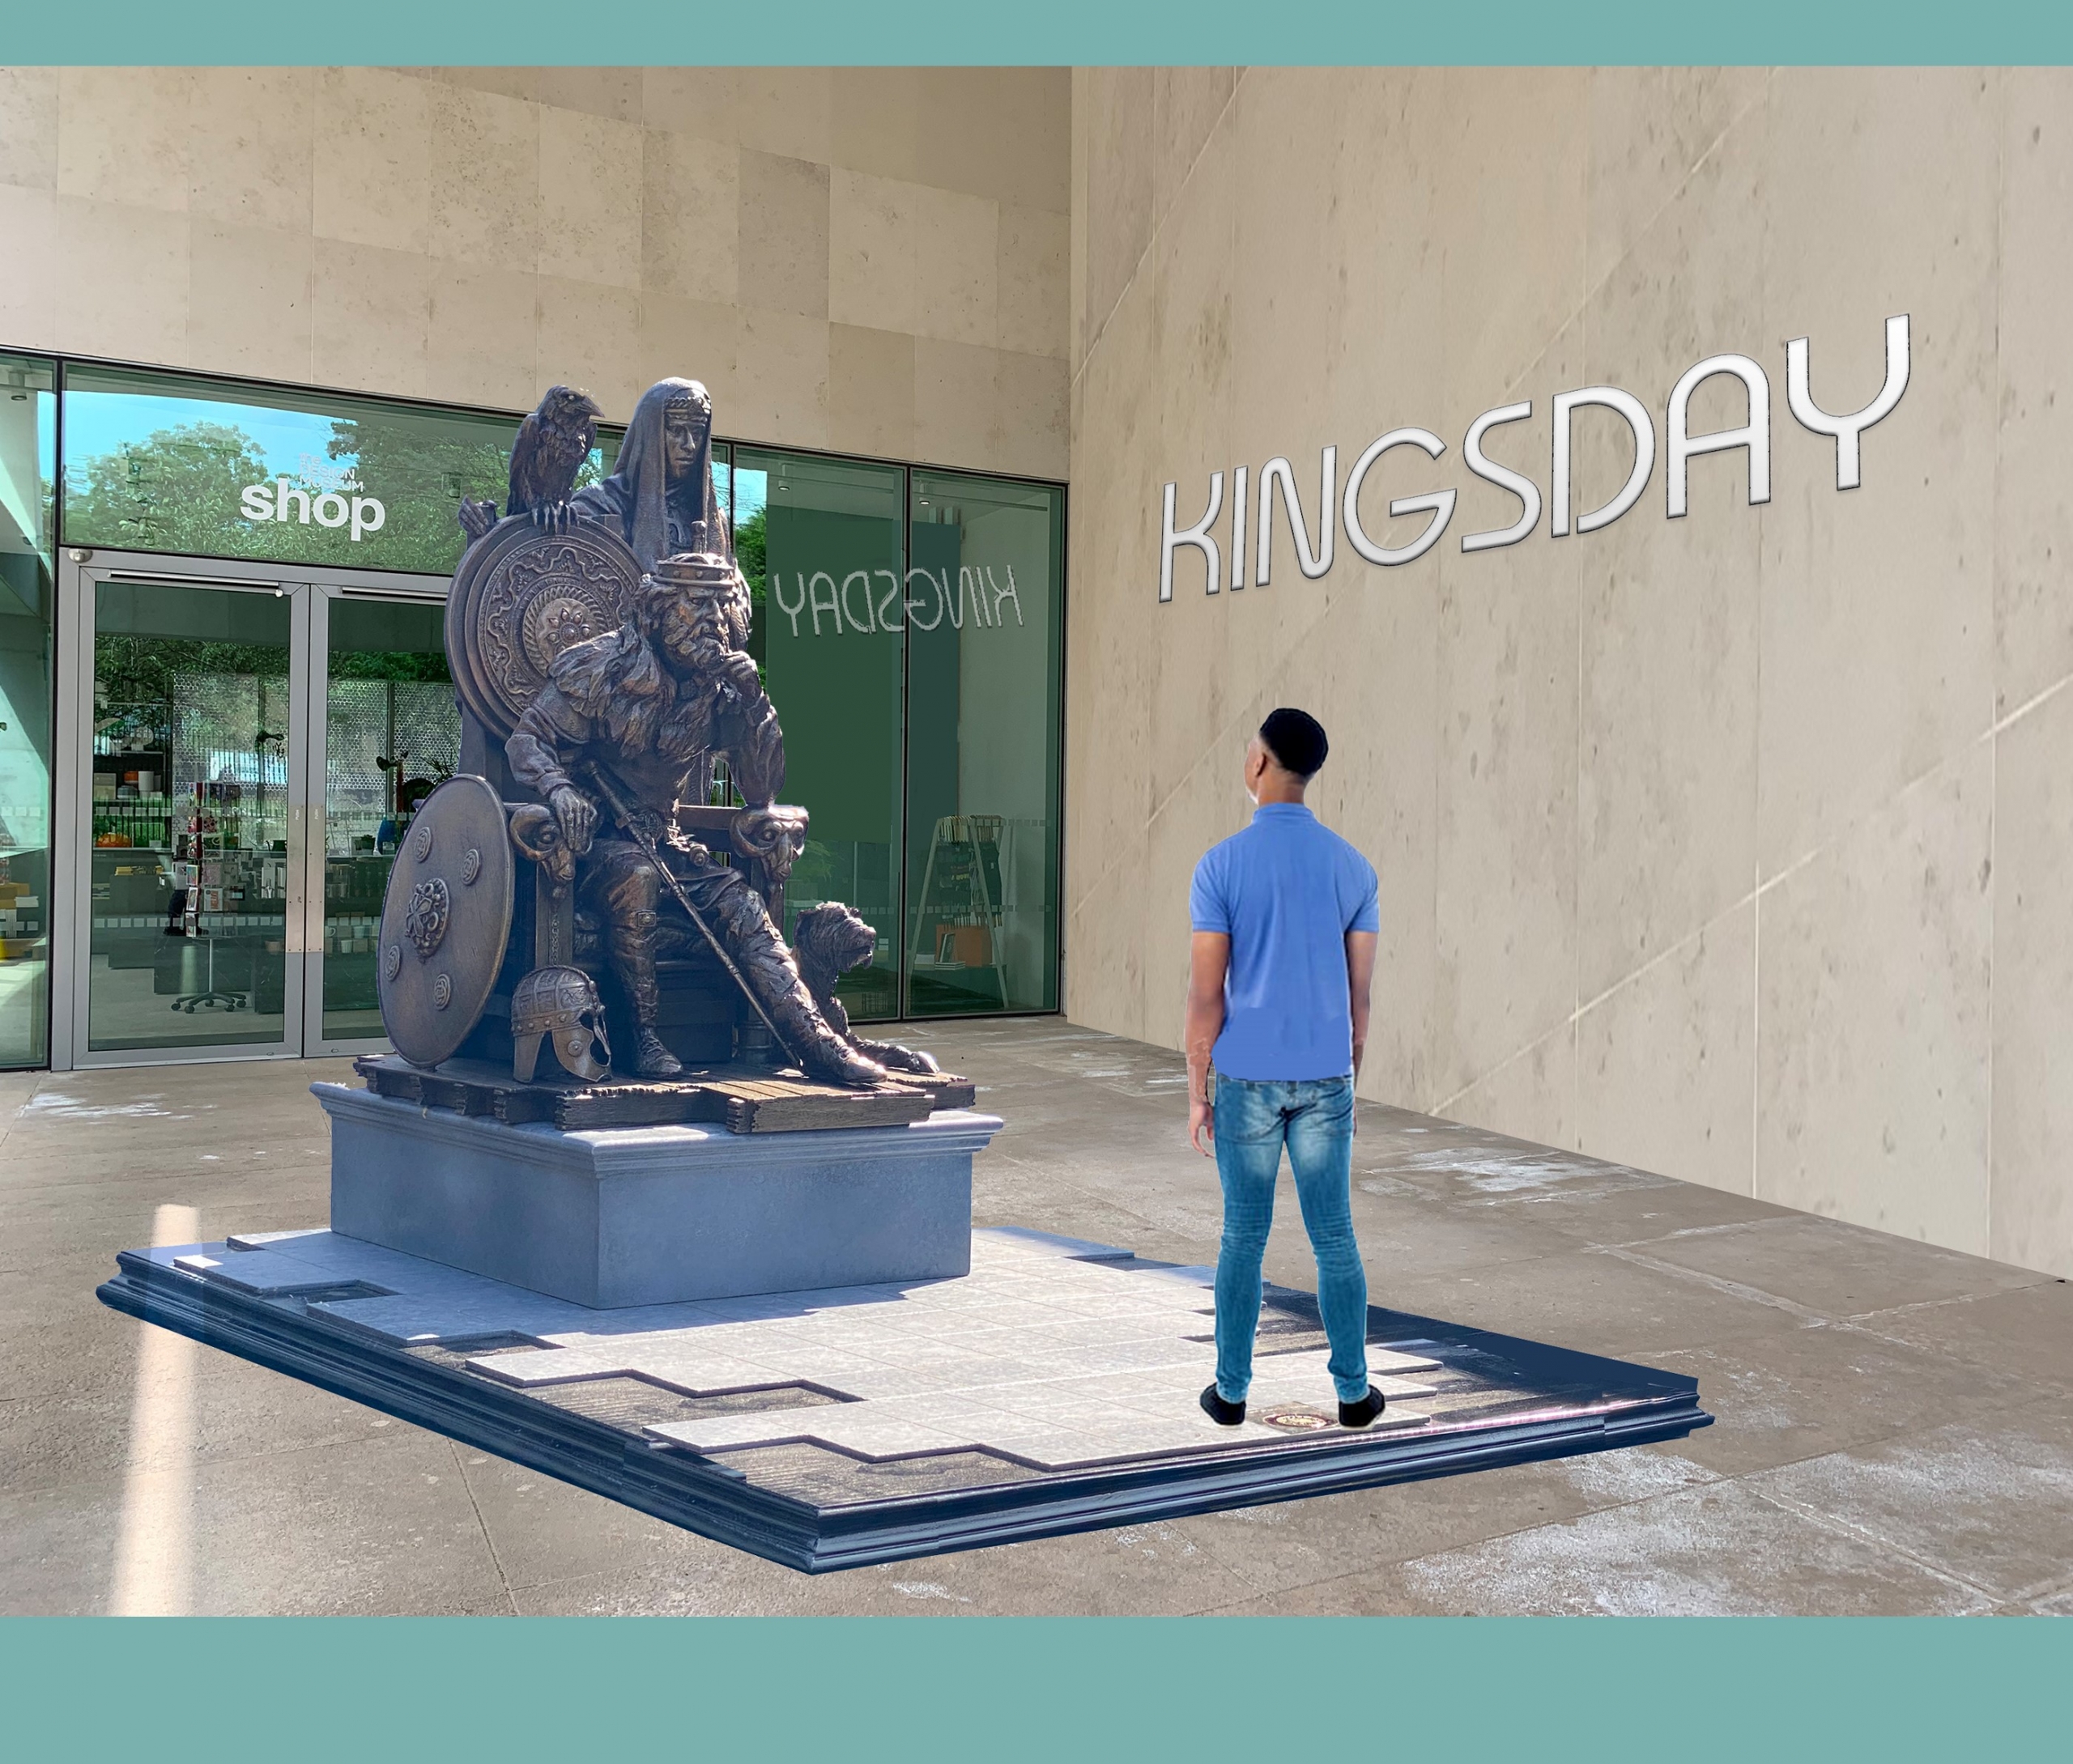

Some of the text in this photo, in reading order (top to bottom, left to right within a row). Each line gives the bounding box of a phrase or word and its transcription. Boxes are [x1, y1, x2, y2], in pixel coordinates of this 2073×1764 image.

[299, 453, 321, 465] the
[1159, 313, 1910, 604] KINGSDAY
[299, 464, 355, 480] DESIGN
[299, 475, 364, 493] MUSEUM
[240, 478, 385, 542] shop
